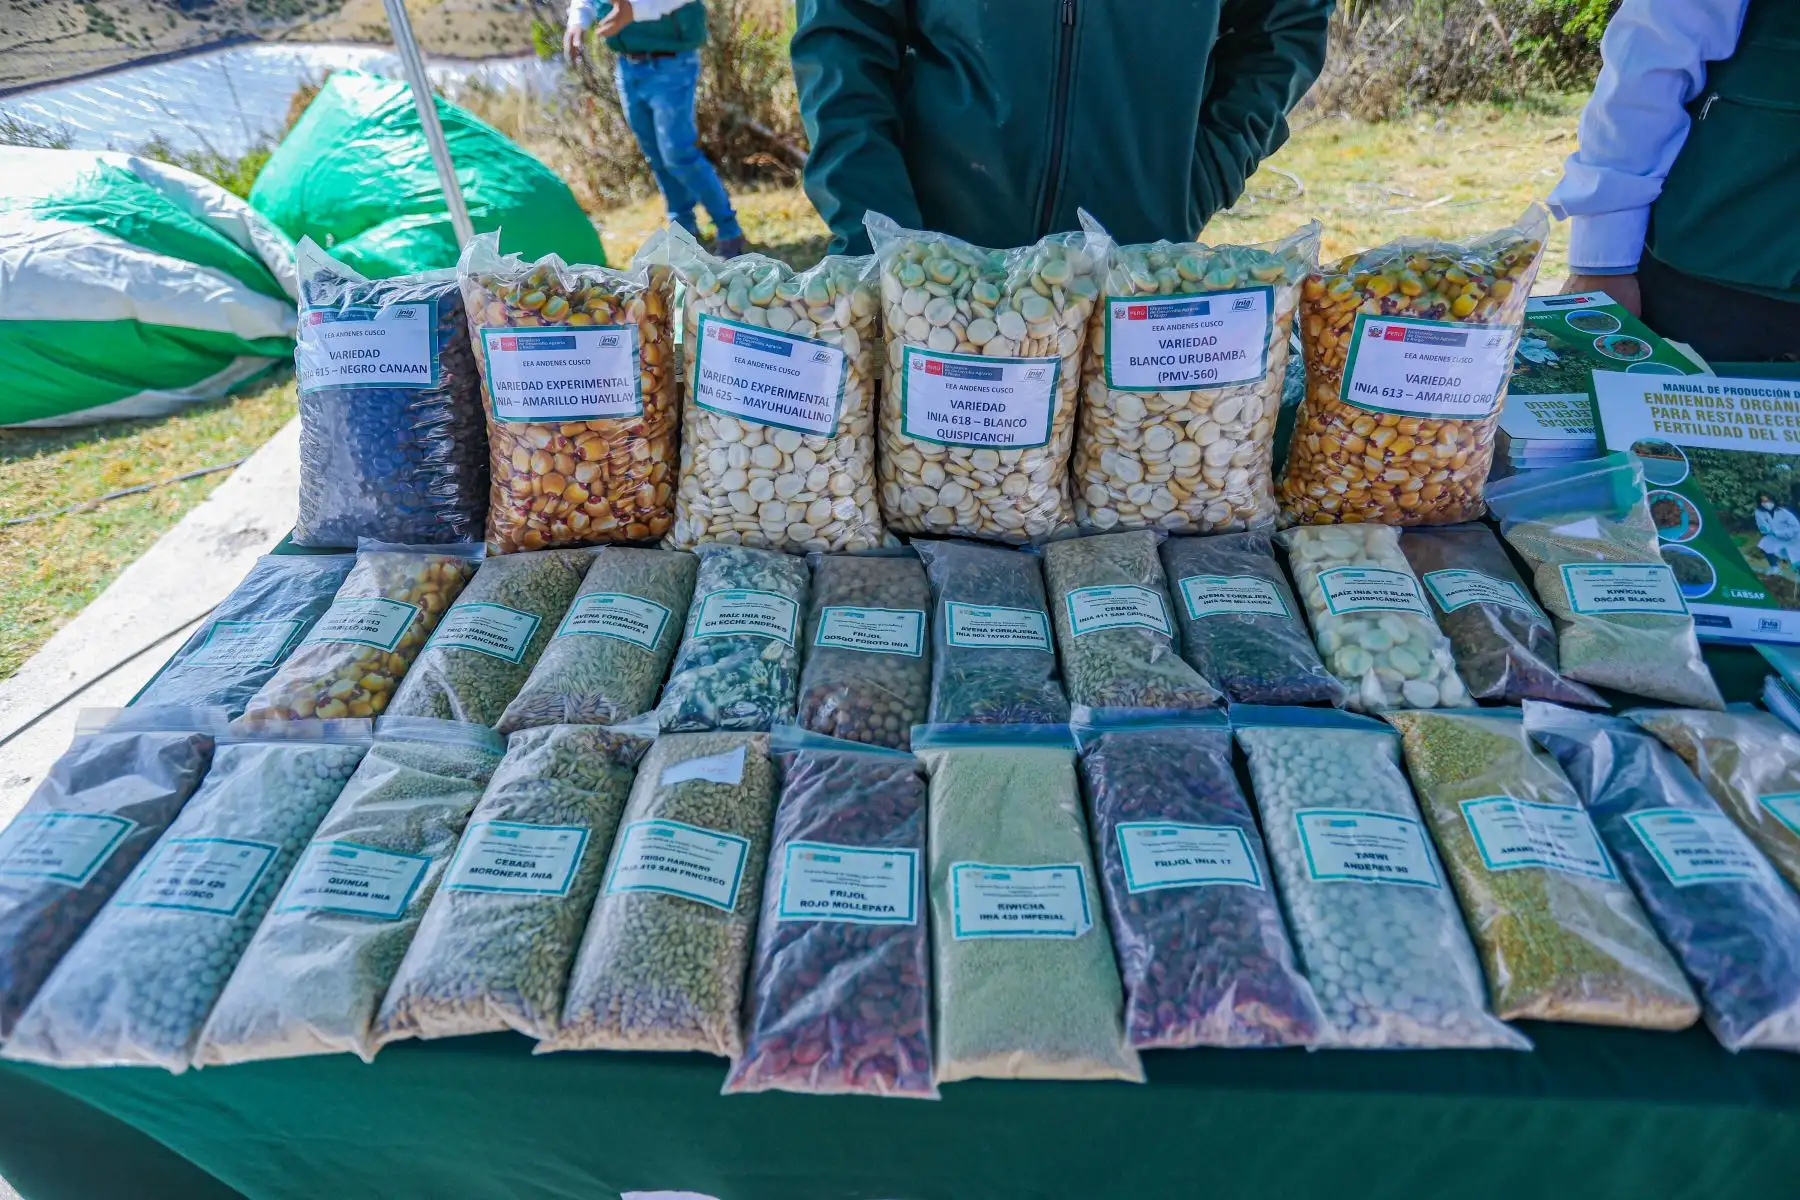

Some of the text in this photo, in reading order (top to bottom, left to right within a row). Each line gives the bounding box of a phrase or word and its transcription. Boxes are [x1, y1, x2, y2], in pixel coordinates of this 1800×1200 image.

[1166, 322, 1199, 332] ANDENES
[1200, 320, 1224, 328] CUSCO
[336, 330, 363, 338] ANDENES
[1158, 336, 1218, 349] VARIEDAD
[329, 349, 380, 360] VARIEDAD
[1129, 349, 1247, 367] BLANCO URUBAMBA
[1404, 352, 1418, 360] EEA
[1419, 354, 1451, 363] ANDENES
[340, 364, 376, 375] NEGRO
[379, 364, 428, 374] CANAAN
[734, 356, 801, 377] EEA ANDENES CUSCO
[1158, 368, 1218, 384] (PMV-560)
[1405, 373, 1462, 388] VARIEDAD
[495, 377, 630, 391] VARIEDAD EXPERIMENTAL
[702, 369, 831, 408] VARIEDAD EXPERIMENTAL
[958, 384, 990, 393] ANDENES
[1354, 382, 1379, 396] INIA
[1382, 387, 1404, 399] 613
[1415, 391, 1471, 404] AMARILLO
[1472, 393, 1493, 404] ORO
[1662, 383, 1705, 394] MANUAL
[1707, 386, 1720, 395] DE
[1723, 386, 1791, 399] PRODUCCIÓN
[522, 395, 578, 407] AMARILLO
[581, 392, 634, 405] HUAYLLAY
[698, 384, 714, 396] INIA
[715, 388, 732, 401] 625
[742, 395, 832, 423] MAYUHUAILLINO
[1643, 392, 1735, 410] ENMIENDAS
[950, 400, 1006, 413] VARIEDAD
[927, 411, 949, 423] INIA
[951, 416, 972, 426] 618
[983, 417, 1027, 428] BLANCO
[1651, 406, 1691, 421] PARA
[936, 428, 1015, 443] QUISPICANCHI
[1653, 420, 1744, 439] FERTILIDAD
[1748, 427, 1778, 441] DEL
[1198, 593, 1274, 601] AVENA FORRAJERA
[1350, 596, 1411, 604] QUISPICANCHI
[601, 613, 649, 630] FORRAJERA
[1079, 615, 1096, 623] INIA
[360, 625, 379, 633] ORO
[602, 620, 641, 633] VILCANOTA
[748, 619, 788, 633] ANDENES
[990, 627, 1039, 635] FORRAJERA
[468, 628, 508, 643] HARINERO
[824, 635, 854, 643] QOSQO
[855, 638, 890, 646] POROTO
[852, 631, 882, 639] FRIJOL
[1154, 858, 1193, 868] FRIJOL
[1195, 857, 1218, 865] INIA
[1354, 852, 1389, 861] TARWI
[494, 858, 537, 869] CEBADA
[640, 855, 711, 873] TRIGO HARINERO
[1343, 861, 1393, 873] ANDENES
[469, 867, 553, 880] MORONERA INIA
[658, 865, 678, 874] SAN
[679, 869, 727, 886] FRNCISCO
[328, 877, 370, 888] QUINUA
[370, 892, 391, 901] INIA
[830, 889, 868, 901] FRIJOL
[800, 899, 896, 913] ROJO MOLLEPATA
[997, 903, 1046, 911] KIWICHA
[1021, 913, 1066, 921] IMPERIAL
